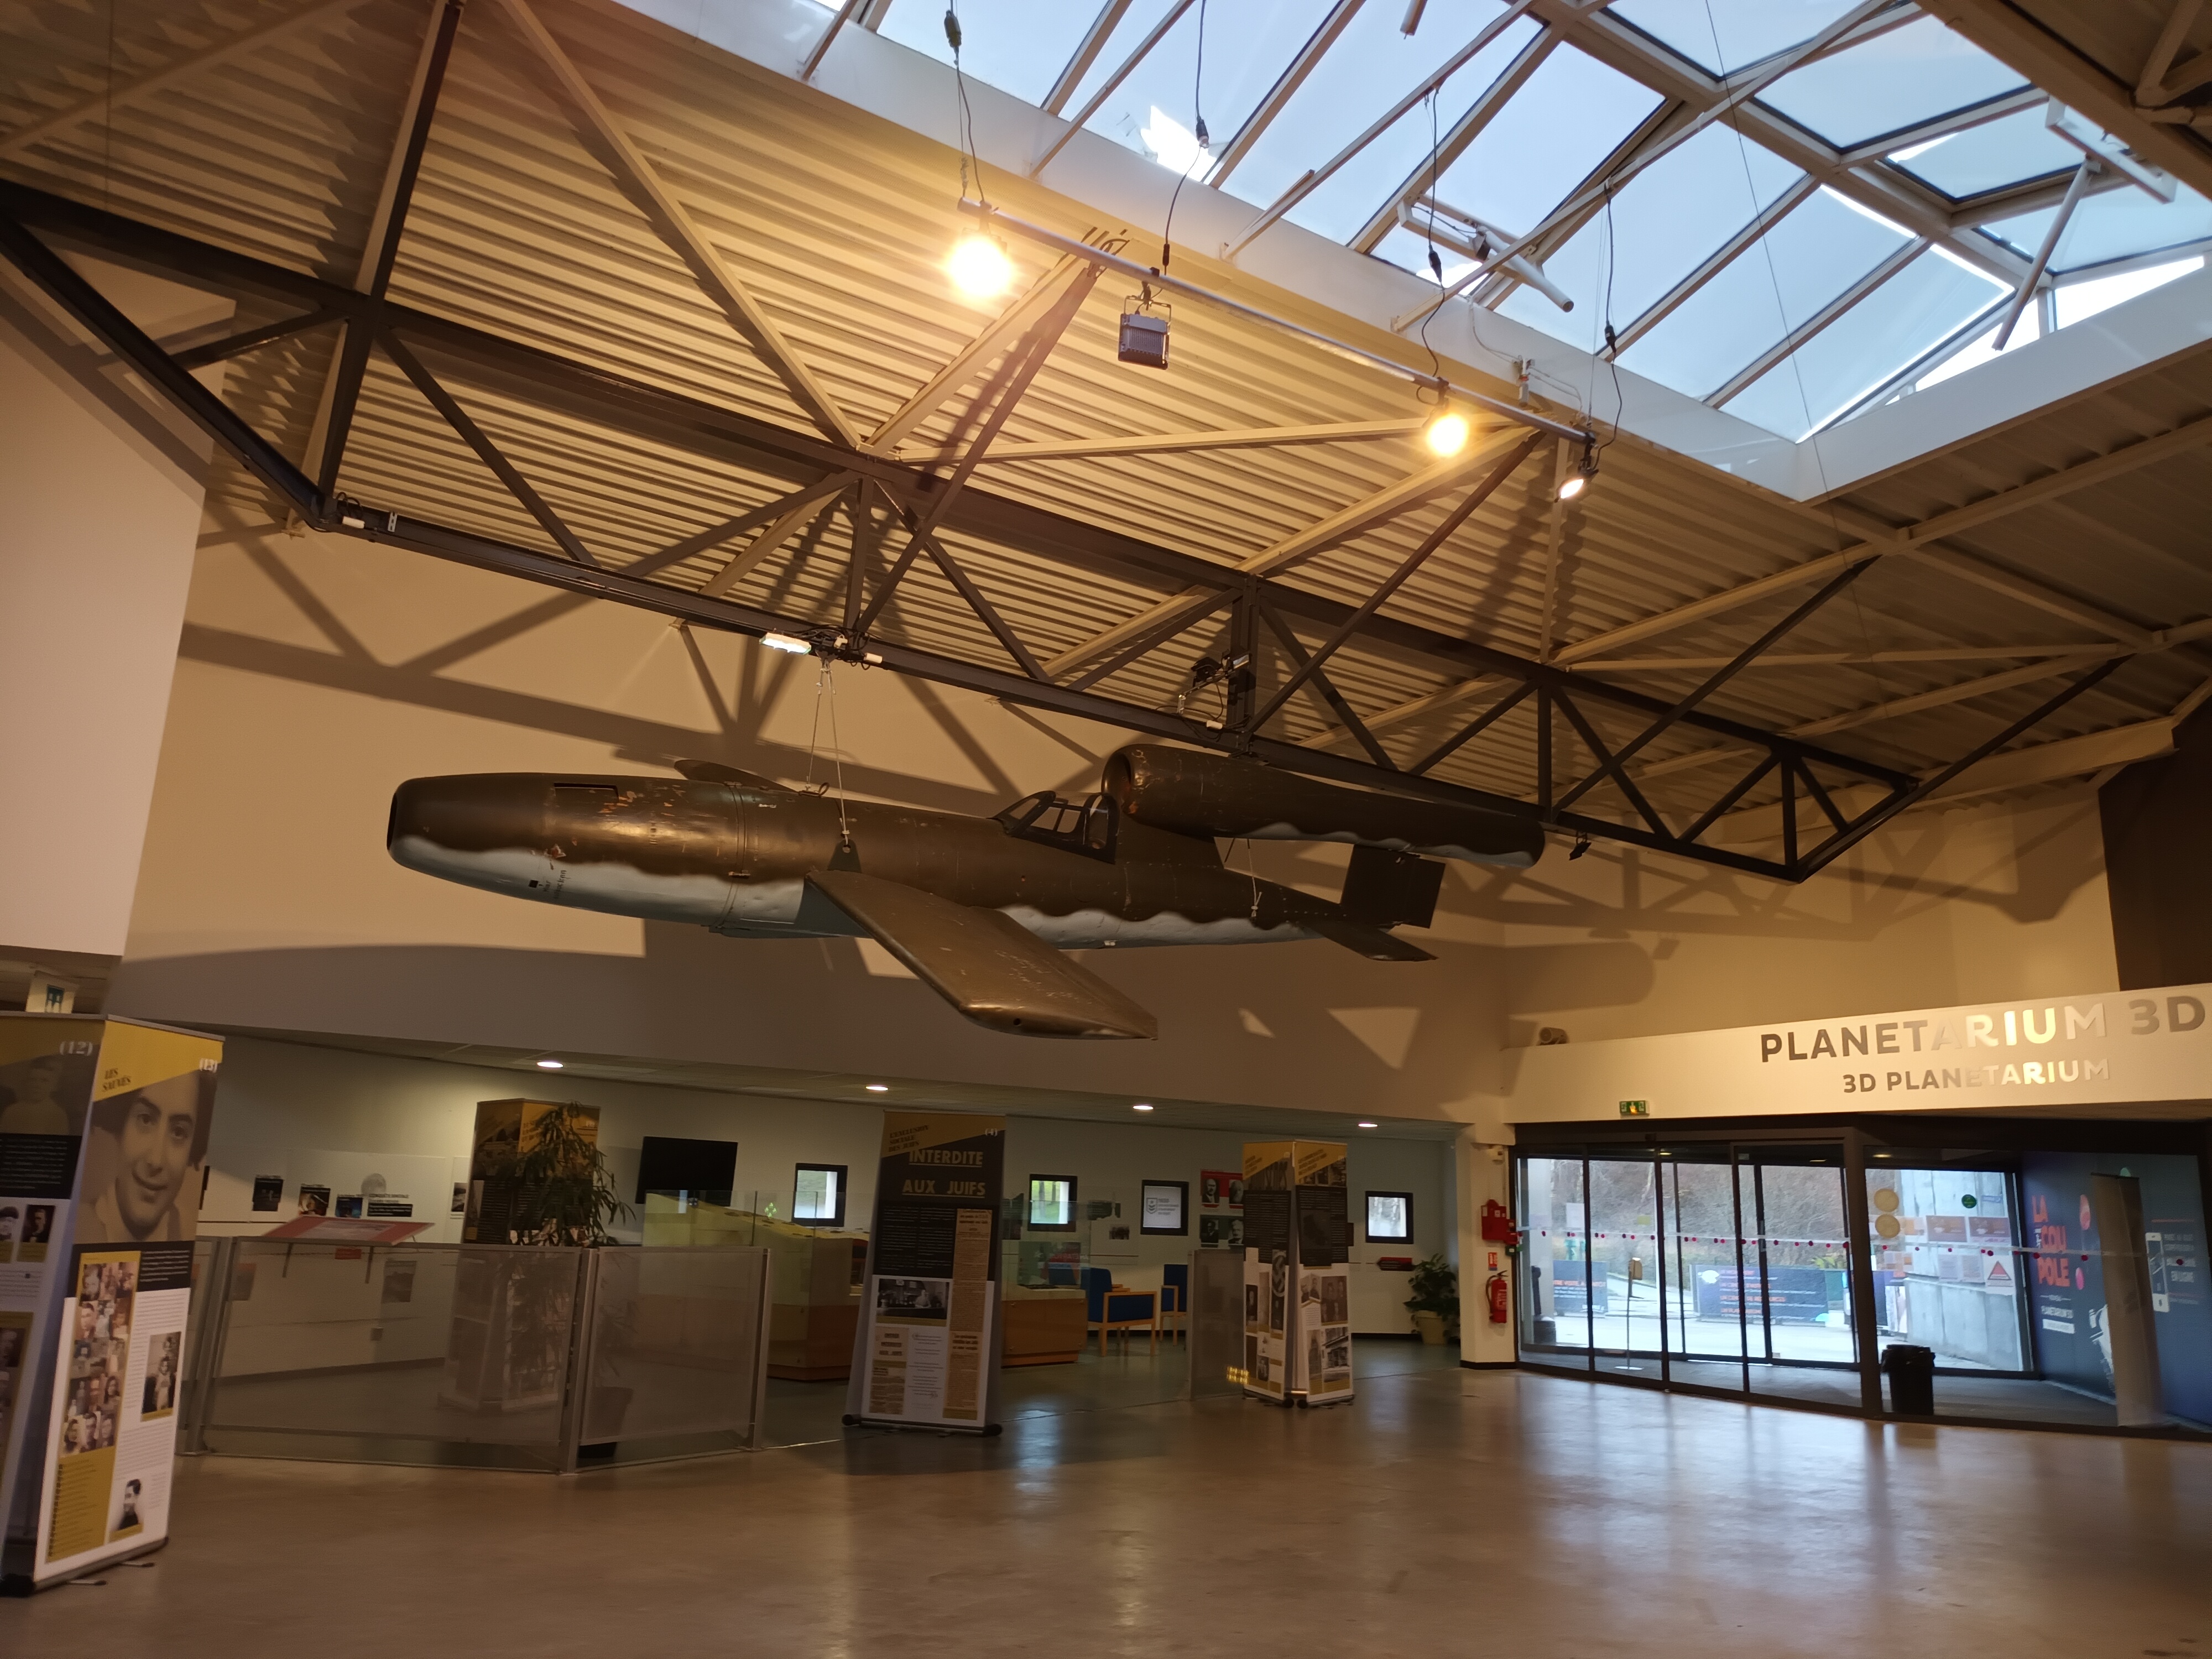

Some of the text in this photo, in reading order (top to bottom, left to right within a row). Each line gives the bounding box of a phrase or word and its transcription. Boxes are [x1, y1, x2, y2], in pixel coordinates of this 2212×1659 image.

[1760, 995, 2206, 1063] PLANETARIUM 3D
[1843, 1058, 2110, 1093] 3D PLANETARIUM
[910, 1150, 983, 1165] INTERDITE
[903, 1179, 986, 1196] AUX JUIFS
